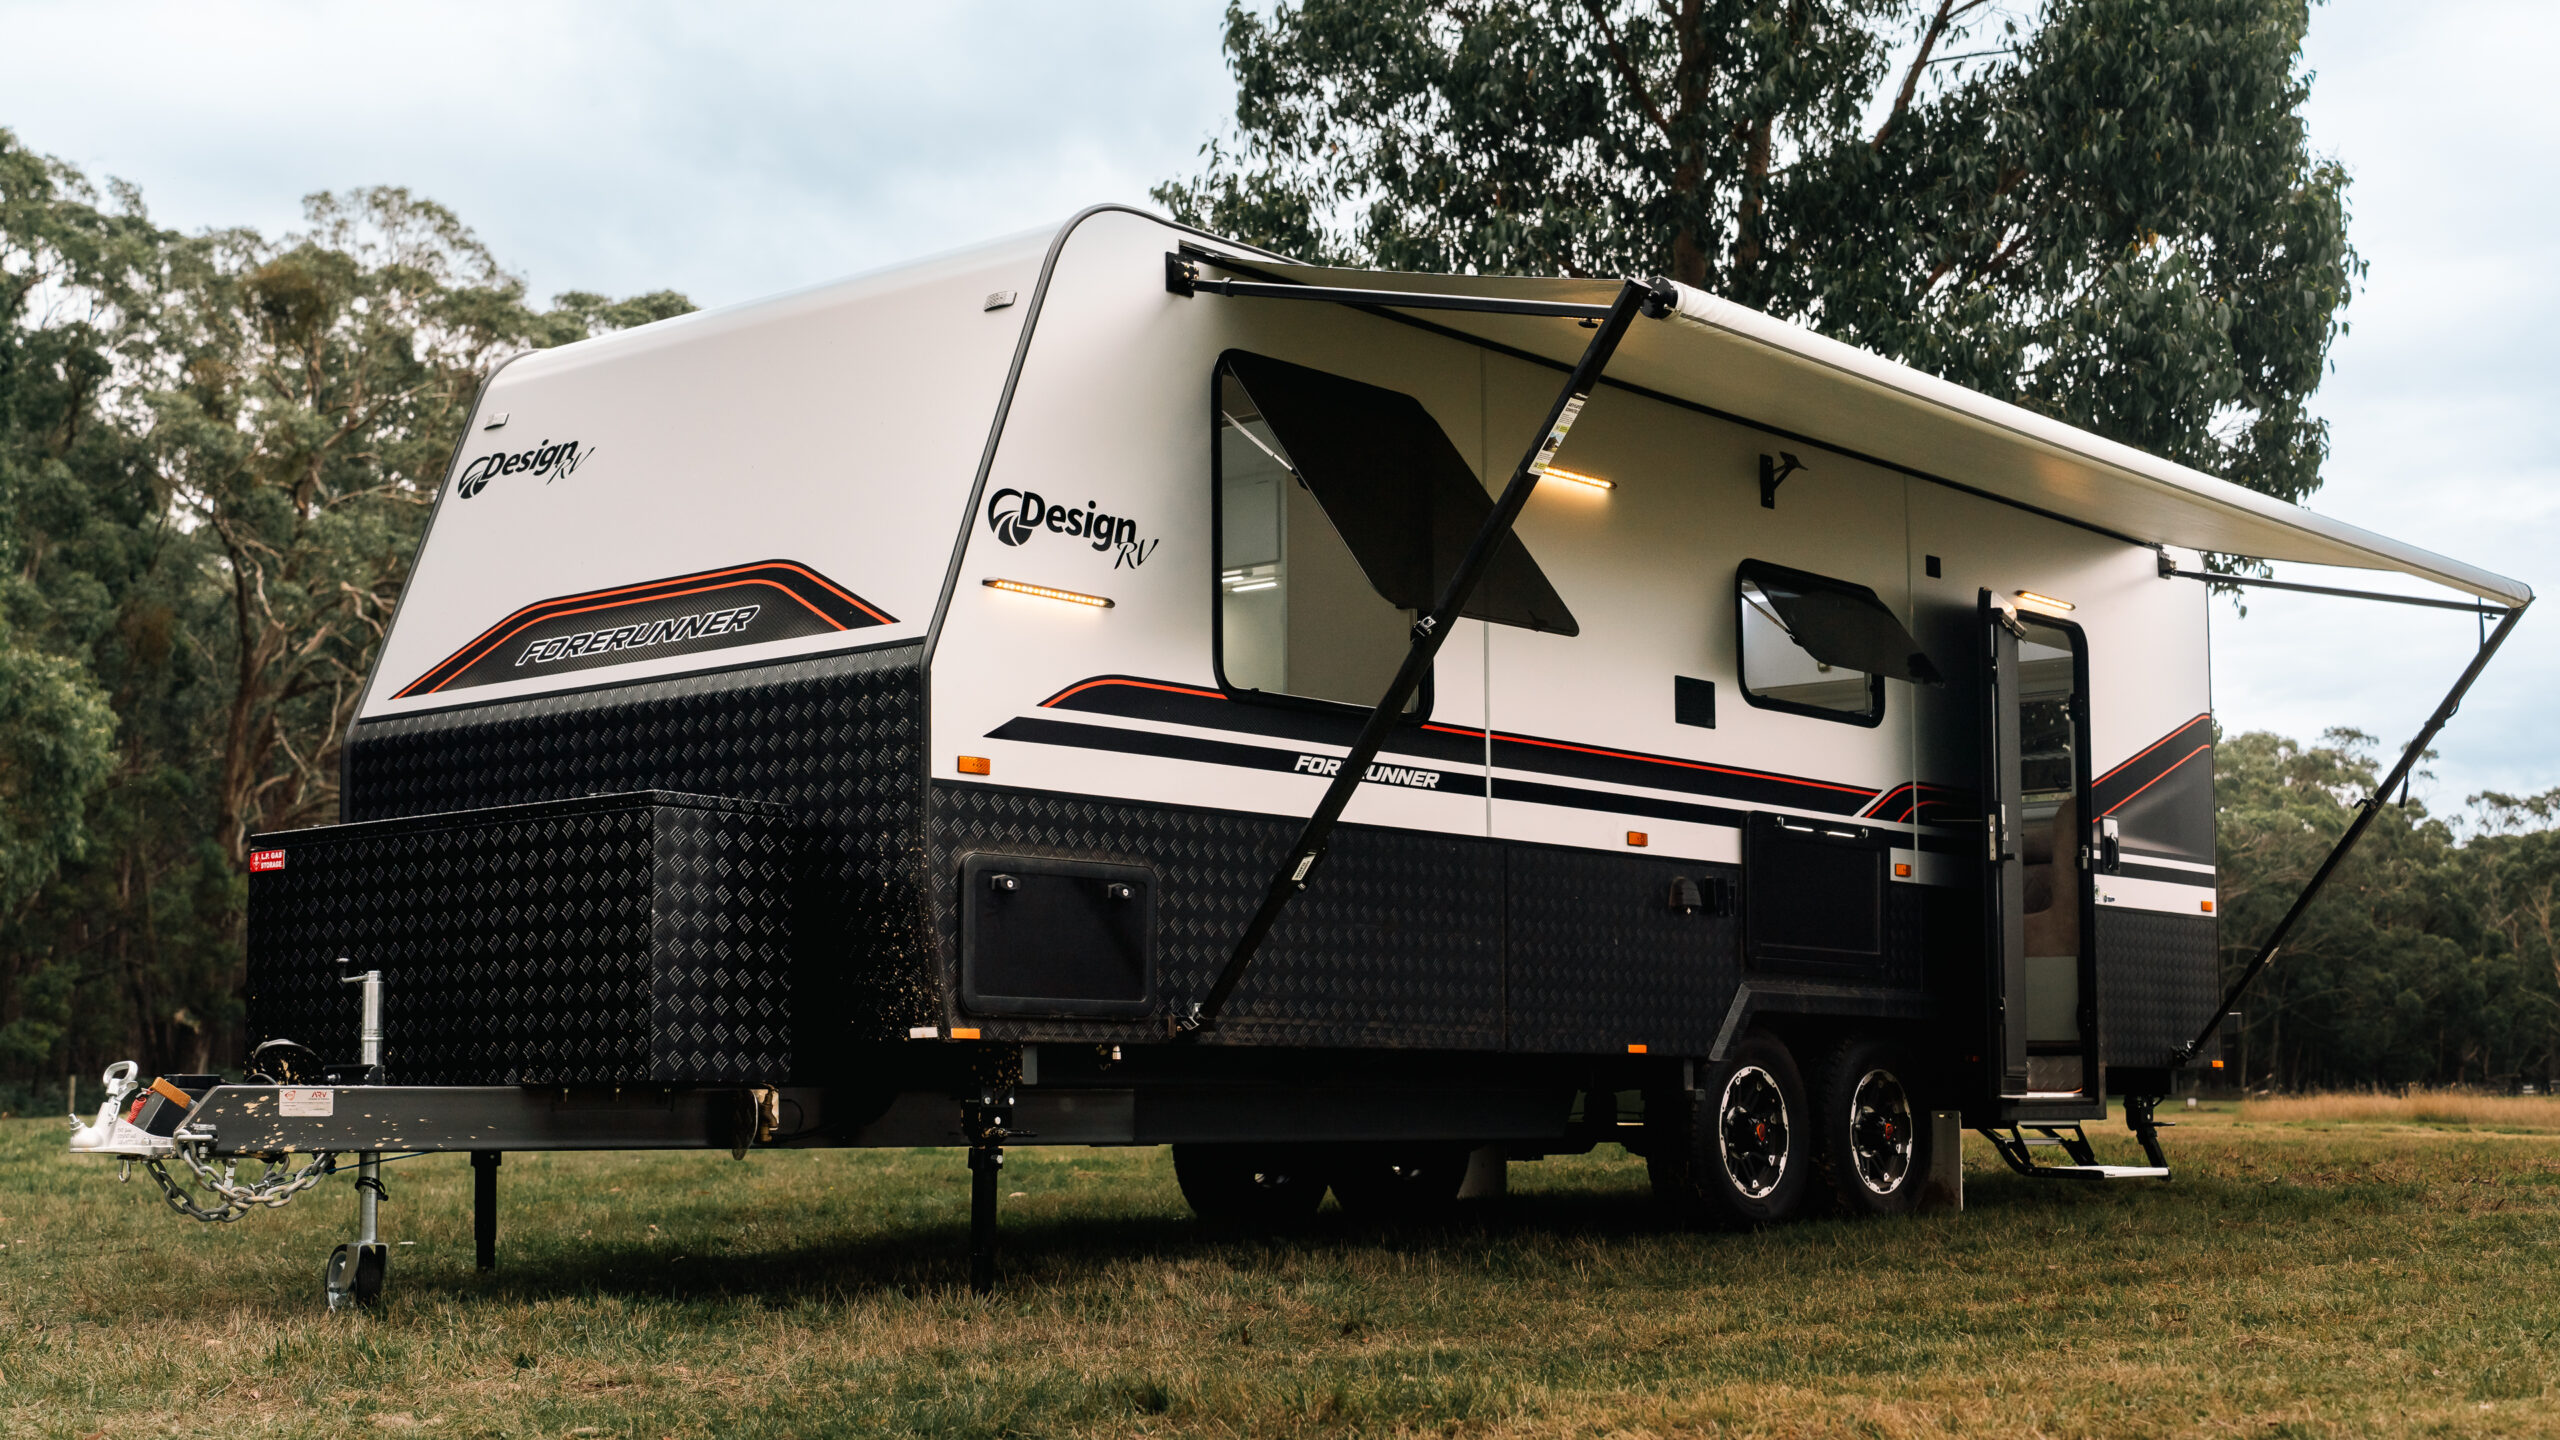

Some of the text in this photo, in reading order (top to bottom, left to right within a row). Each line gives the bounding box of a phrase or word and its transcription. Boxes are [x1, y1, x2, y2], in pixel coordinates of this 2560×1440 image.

[481, 439, 595, 485] Design RV
[1018, 490, 1160, 570] Design RV
[515, 604, 761, 667] FORERUNNER
[1294, 754, 1441, 789] FORUNNER
[261, 861, 282, 869] STORAGE
[271, 851, 282, 859] GAS
